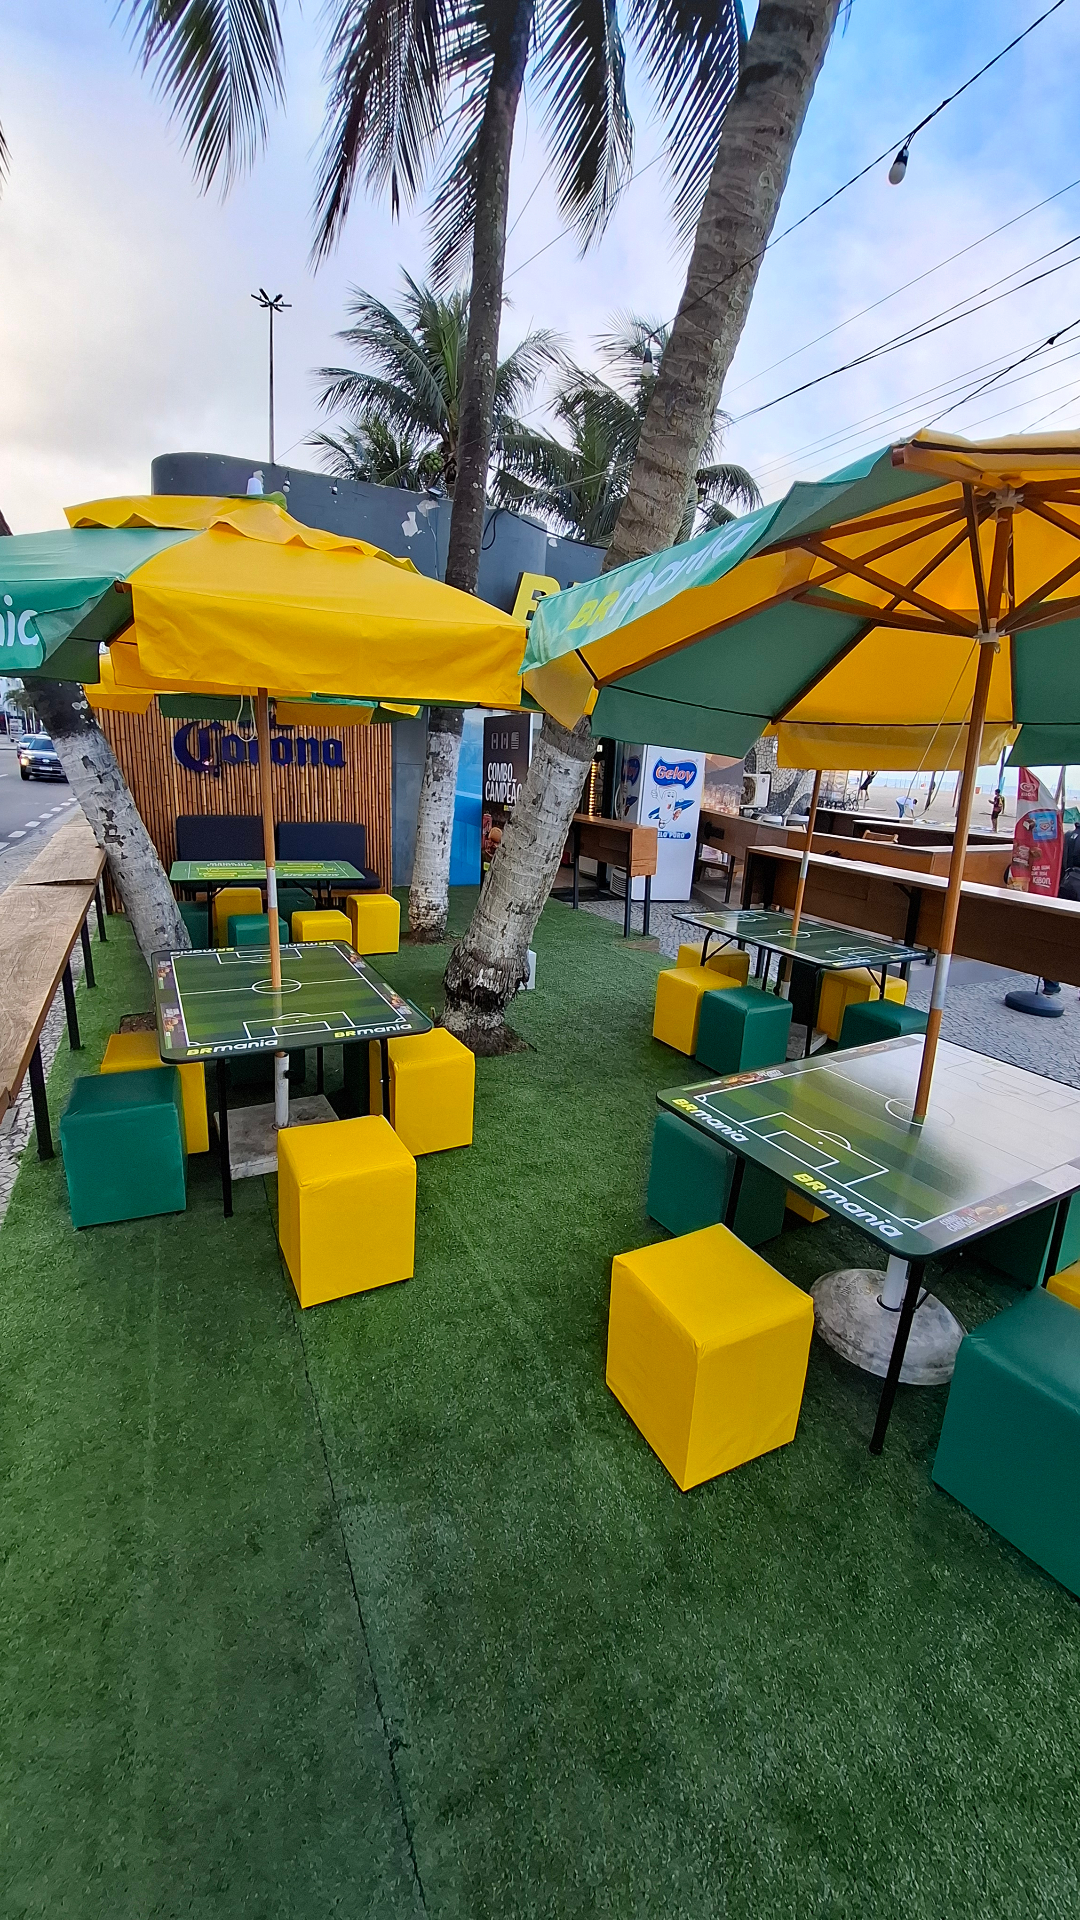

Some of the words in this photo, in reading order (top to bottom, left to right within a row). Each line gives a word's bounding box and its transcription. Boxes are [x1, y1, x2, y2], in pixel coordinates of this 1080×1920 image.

[567, 519, 761, 631] BRmania
[487, 762, 513, 783] COMBO
[656, 765, 695, 784] Geloy
[334, 1023, 413, 1039] BRmania
[186, 1039, 279, 1056] BRmania
[672, 1098, 750, 1143] BRmania
[793, 1173, 904, 1238] BRmania
